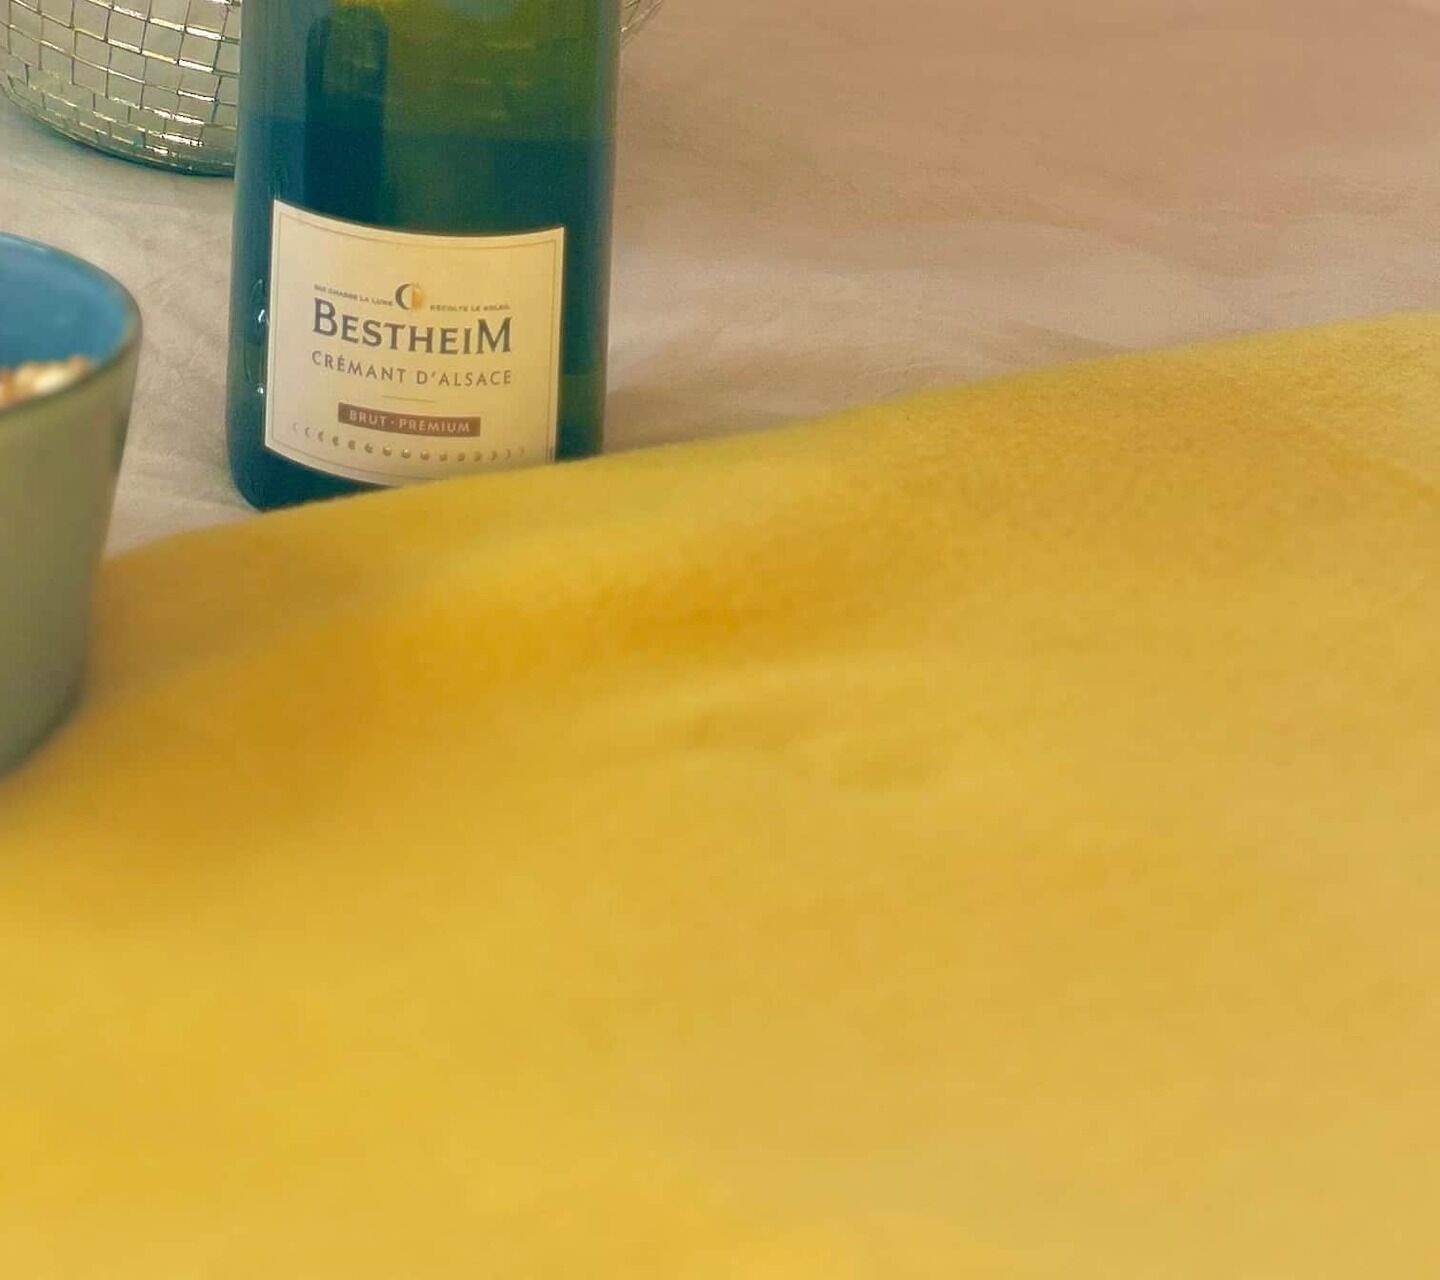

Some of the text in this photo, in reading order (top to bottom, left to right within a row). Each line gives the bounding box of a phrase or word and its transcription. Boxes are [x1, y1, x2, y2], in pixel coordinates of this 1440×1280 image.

[312, 297, 512, 355] BESTHEIM
[312, 350, 511, 387] CRÉMANT D'ALSACE
[349, 409, 386, 427] BRUT
